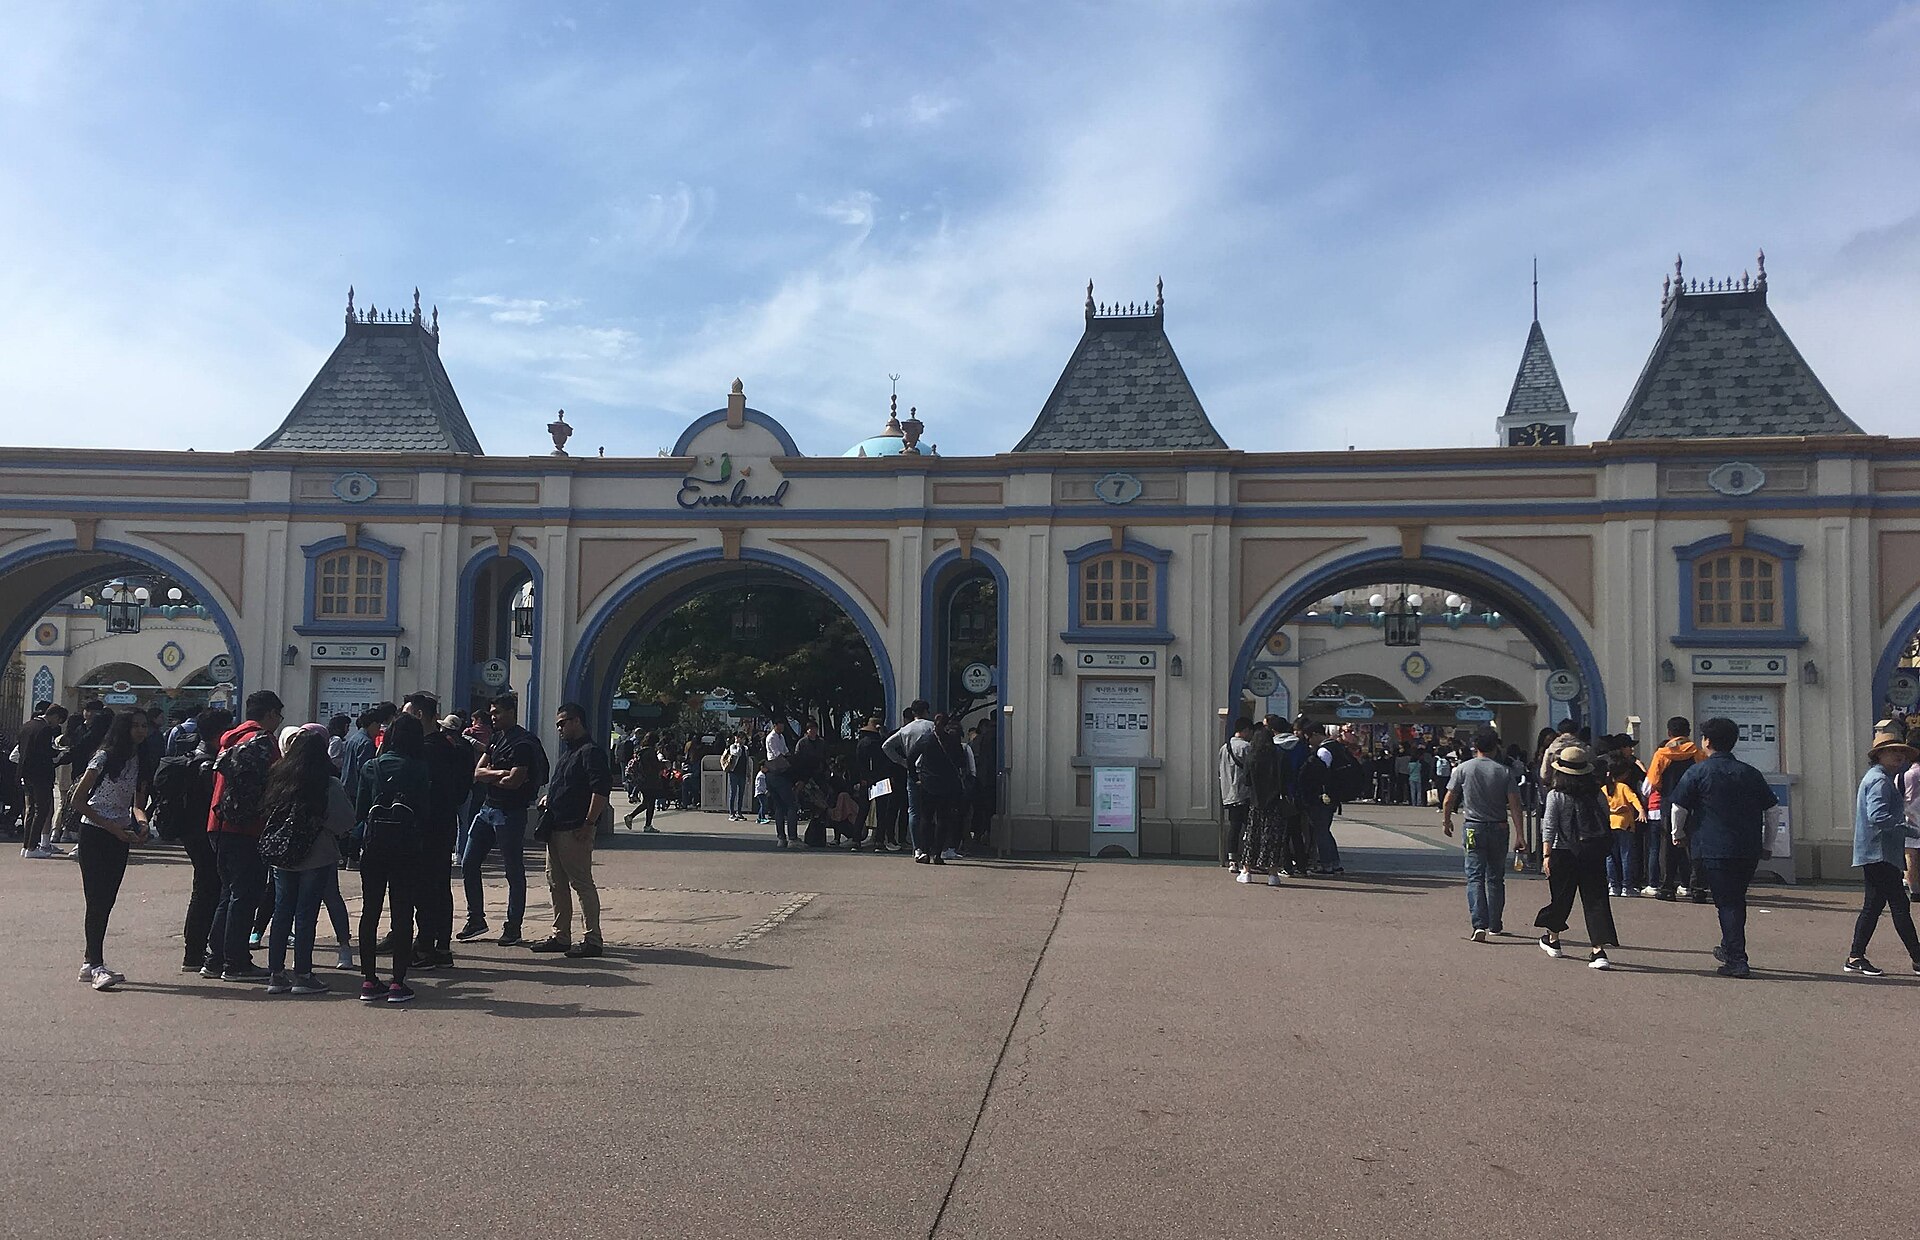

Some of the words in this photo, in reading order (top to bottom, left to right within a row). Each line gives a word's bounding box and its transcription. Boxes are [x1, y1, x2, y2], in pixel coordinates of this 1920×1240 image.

[350, 479, 361, 496] 6
[677, 477, 790, 509] Everland
[1112, 480, 1125, 497] 7
[166, 649, 176, 662] 6
[1410, 661, 1420, 674] 2
